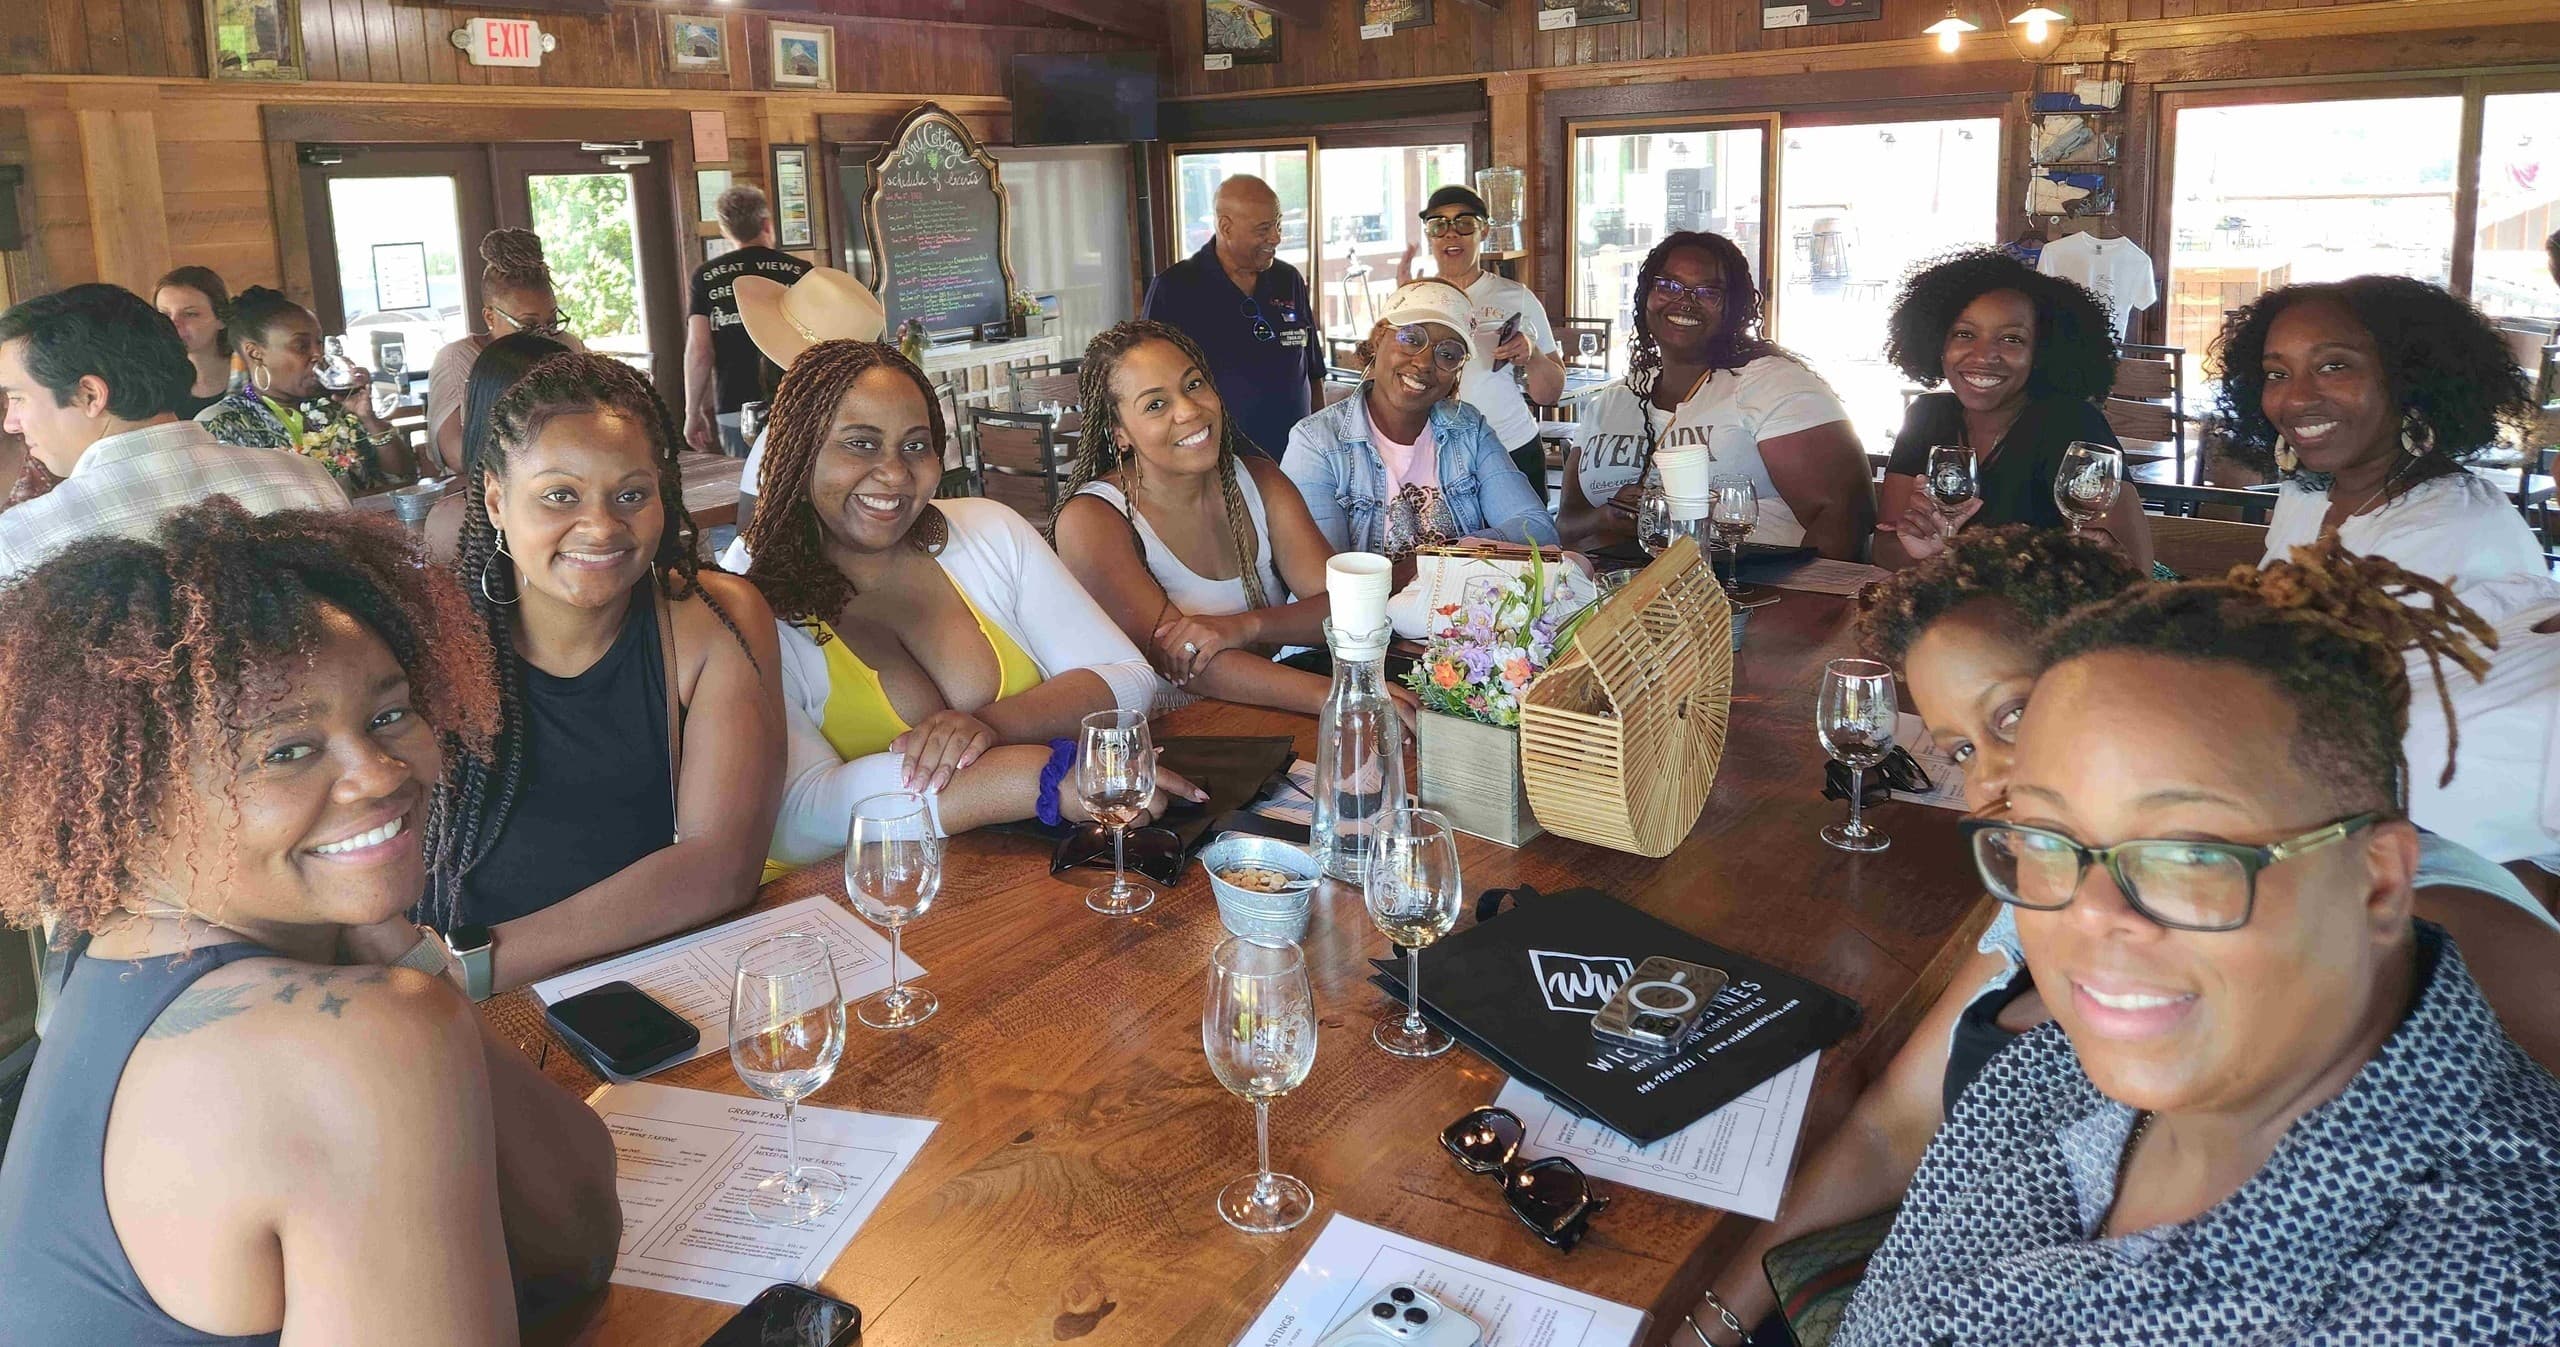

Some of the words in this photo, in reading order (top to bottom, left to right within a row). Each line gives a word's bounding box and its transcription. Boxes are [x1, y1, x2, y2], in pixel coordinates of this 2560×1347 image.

[486, 22, 529, 58] EXIT
[923, 121, 979, 169] Cottage
[884, 171, 929, 189] schedule
[929, 170, 942, 191] of
[703, 262, 745, 281] GREAT
[756, 261, 801, 275] VIEWS
[708, 285, 733, 300] GRE
[1580, 425, 1718, 473] EVERY
[1704, 1016, 1732, 1032] COOL
[1730, 996, 1767, 1018] PEOPLE
[727, 1106, 760, 1117] GROUP
[760, 1111, 809, 1124] TASTGS
[814, 1157, 847, 1167] TASTING
